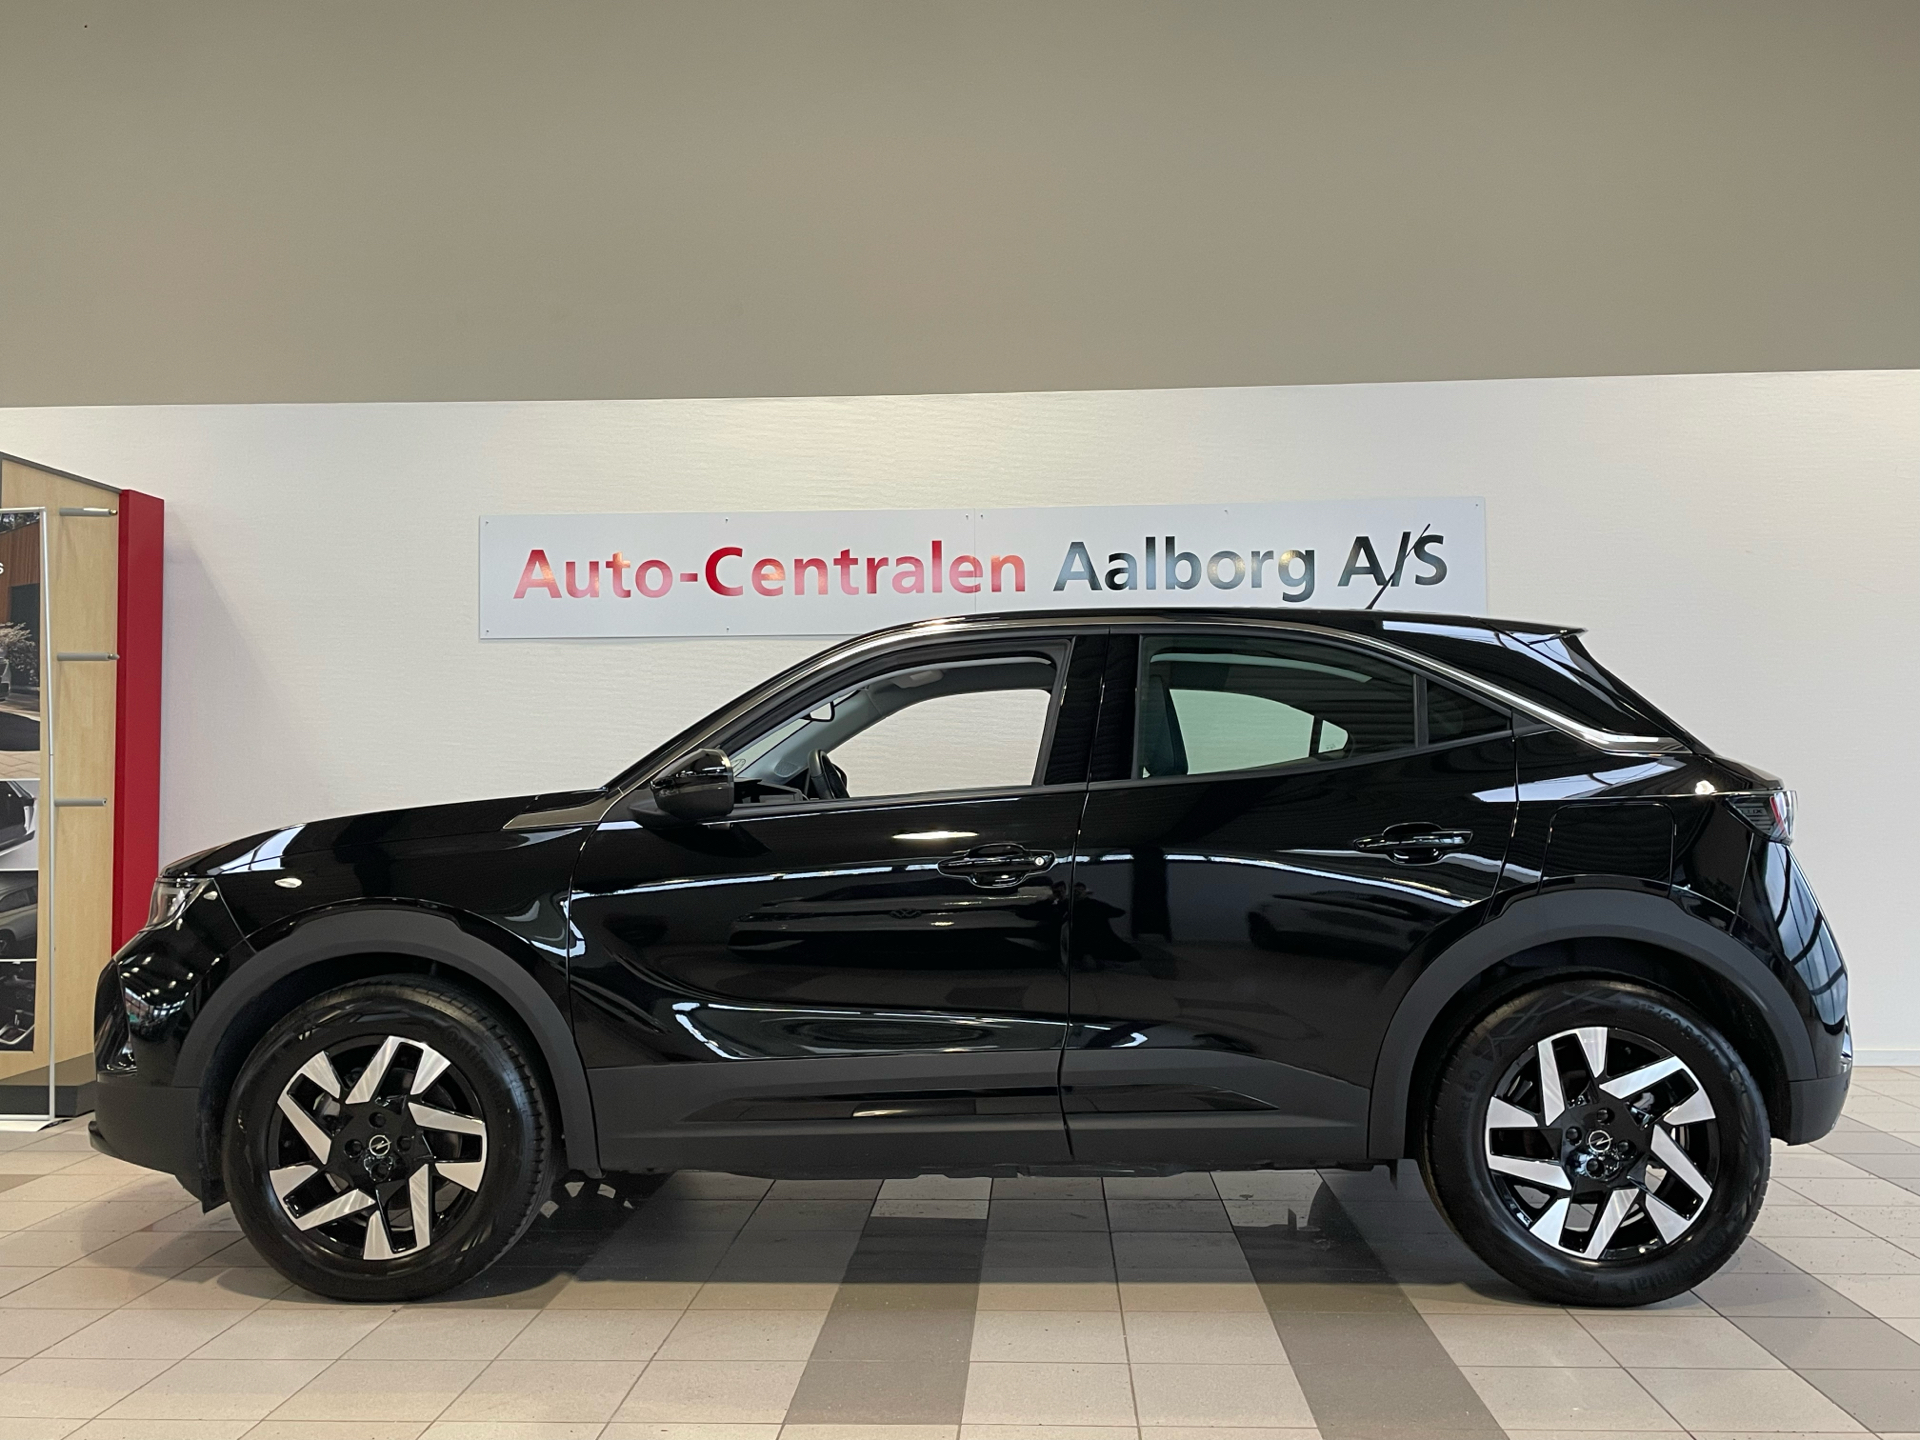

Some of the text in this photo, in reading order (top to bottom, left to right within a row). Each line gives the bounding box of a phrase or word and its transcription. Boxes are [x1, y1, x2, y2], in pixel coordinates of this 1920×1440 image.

[513, 531, 1447, 602] Auto-Centralen Aalborg A/S
